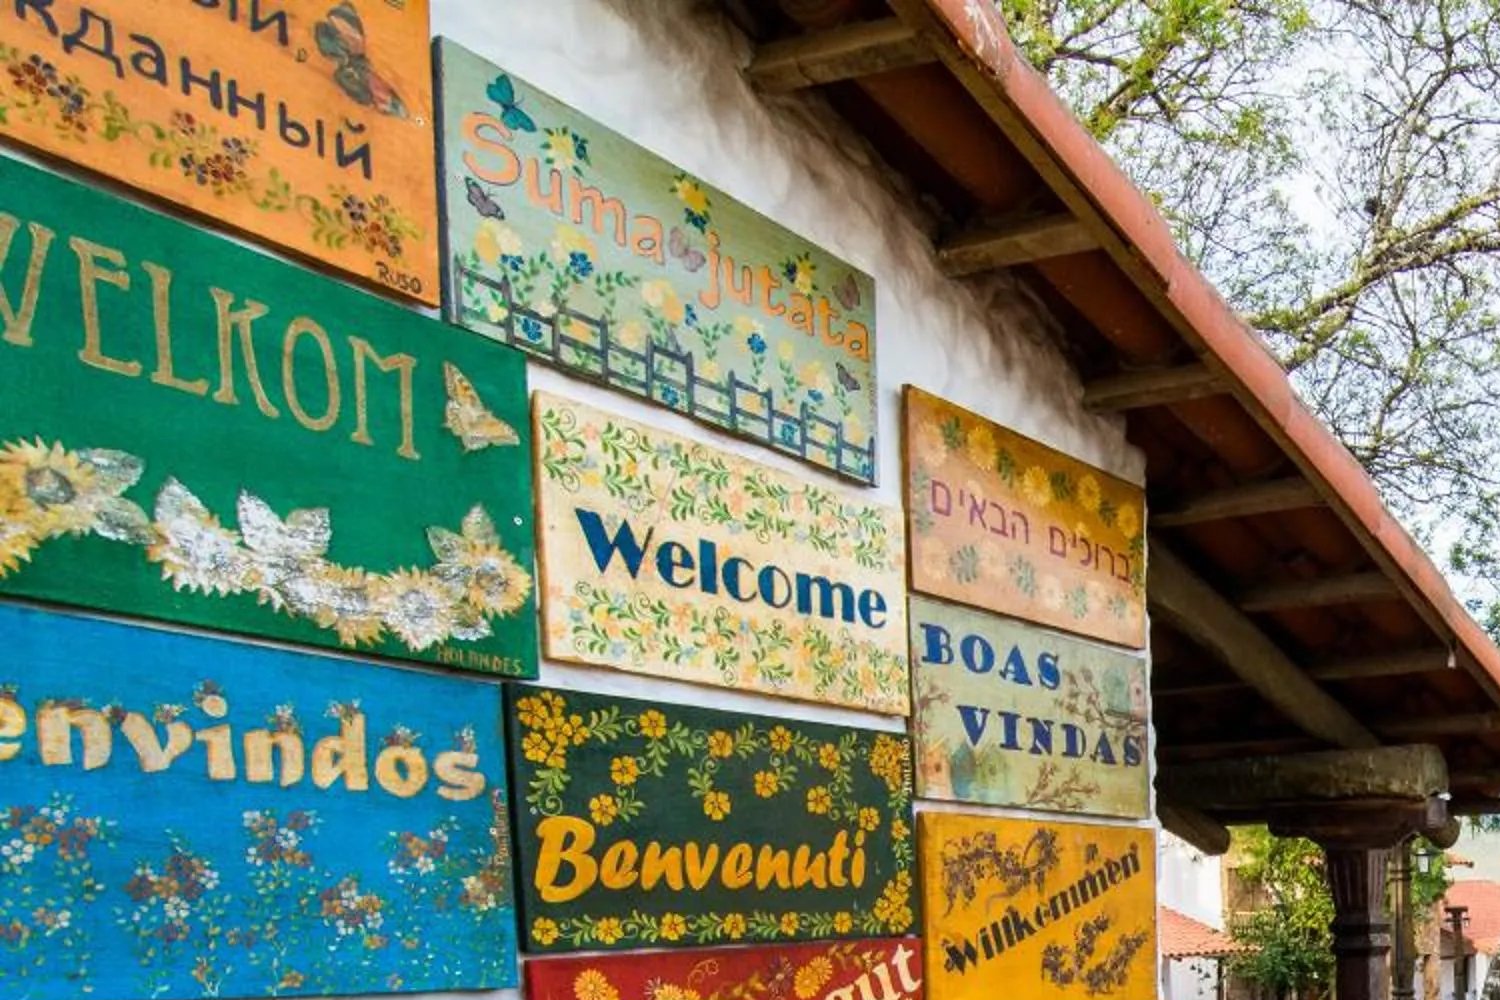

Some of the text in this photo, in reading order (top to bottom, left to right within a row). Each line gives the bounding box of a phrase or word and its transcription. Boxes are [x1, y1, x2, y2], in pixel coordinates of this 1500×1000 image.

[462, 111, 870, 363] Suma jutata
[931, 479, 1030, 545] הבאים
[574, 507, 887, 629] Welcome
[919, 622, 1061, 690] BOAS
[956, 704, 1142, 767] VINDAS
[533, 815, 866, 903] Benvenuti
